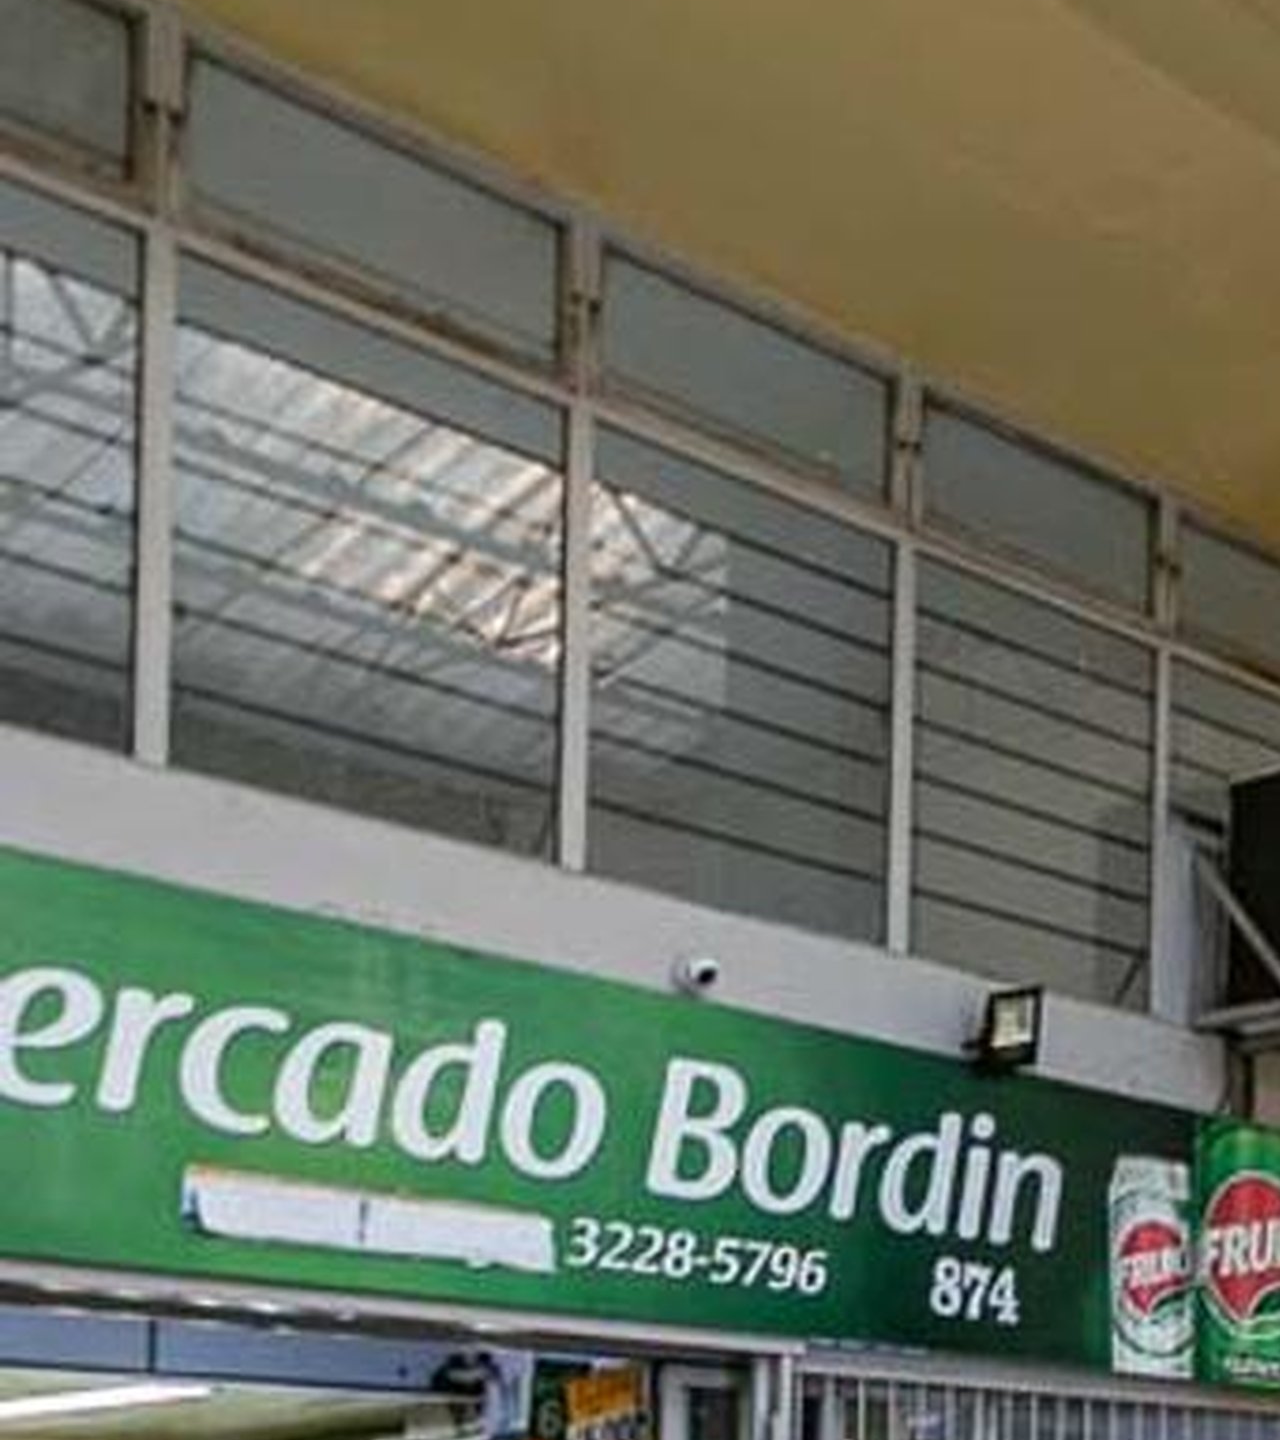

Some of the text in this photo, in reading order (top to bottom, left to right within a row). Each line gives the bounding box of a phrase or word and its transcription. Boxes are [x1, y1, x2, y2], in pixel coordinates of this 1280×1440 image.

[645, 1055, 1064, 1252] Bordin
[568, 1216, 829, 1295] 3228-5796
[929, 1257, 1020, 1325] 874
